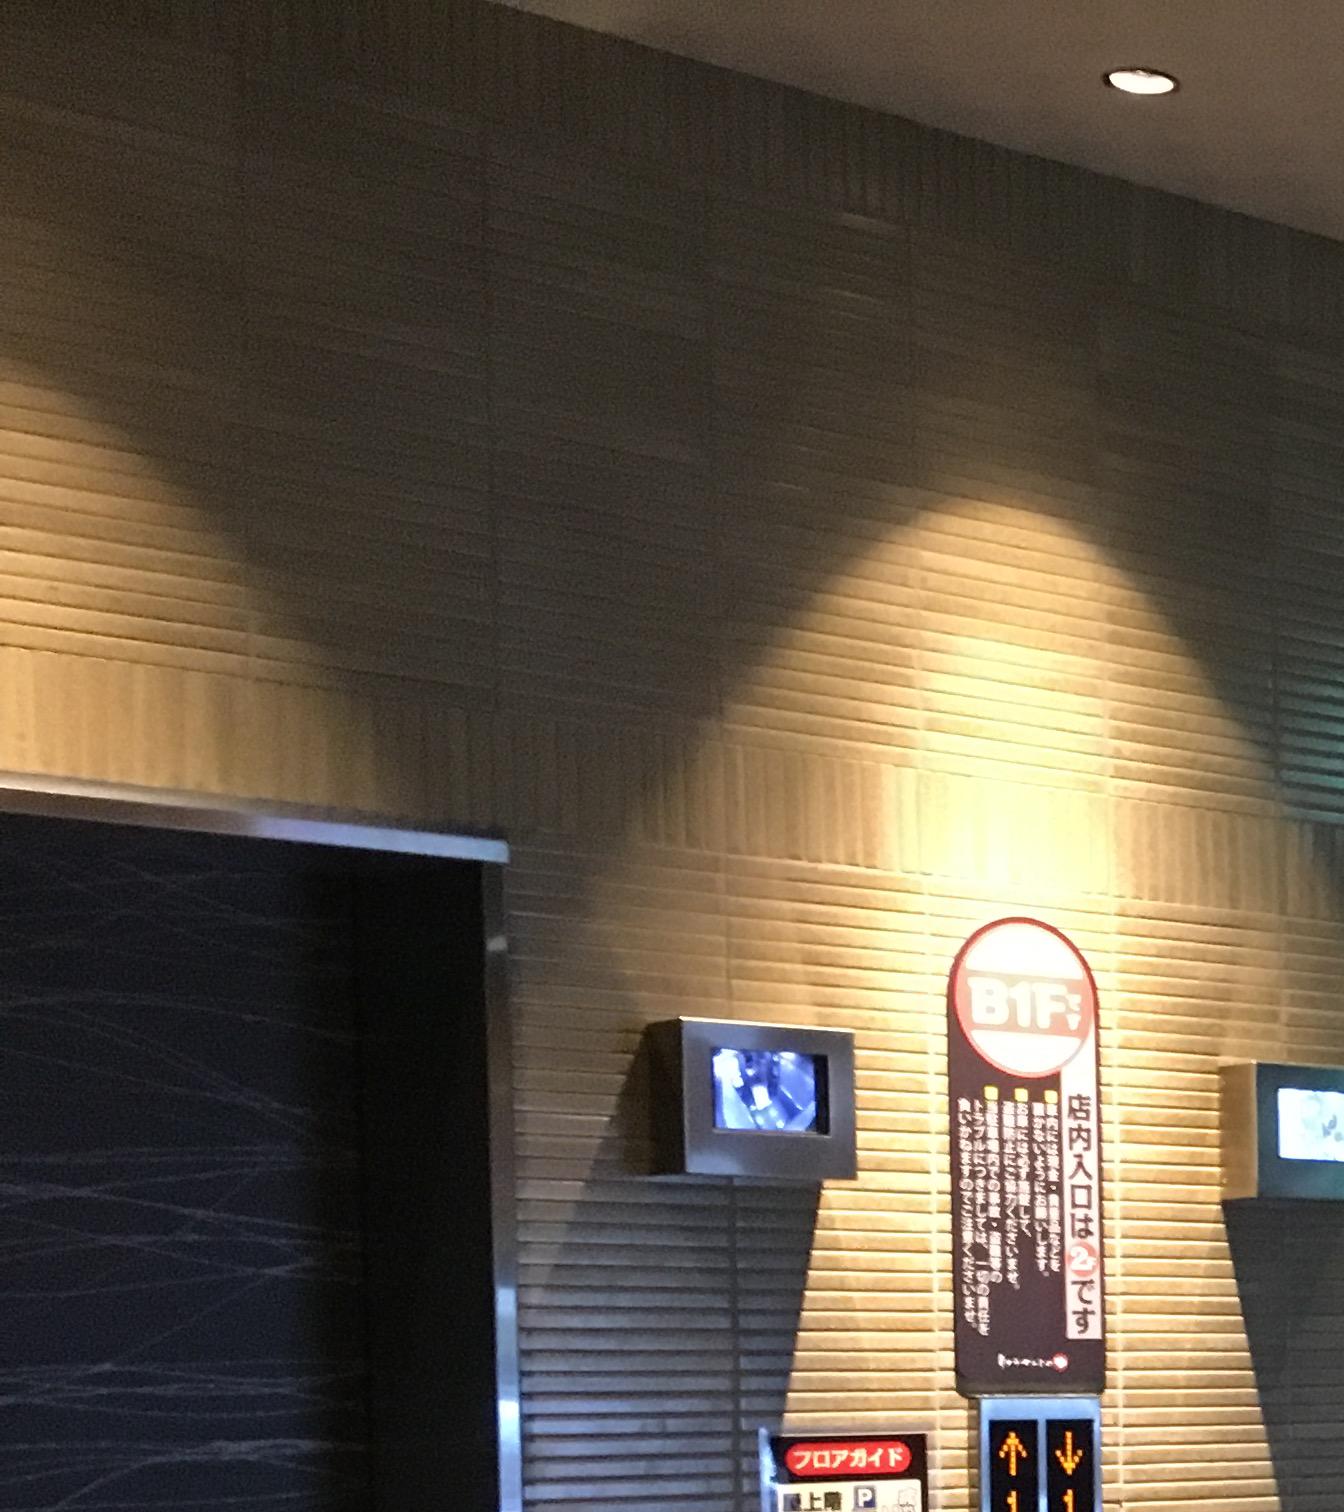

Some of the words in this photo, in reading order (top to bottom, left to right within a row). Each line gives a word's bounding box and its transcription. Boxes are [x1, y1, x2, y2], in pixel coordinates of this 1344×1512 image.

[794, 1447, 903, 1470] フロアガイド
